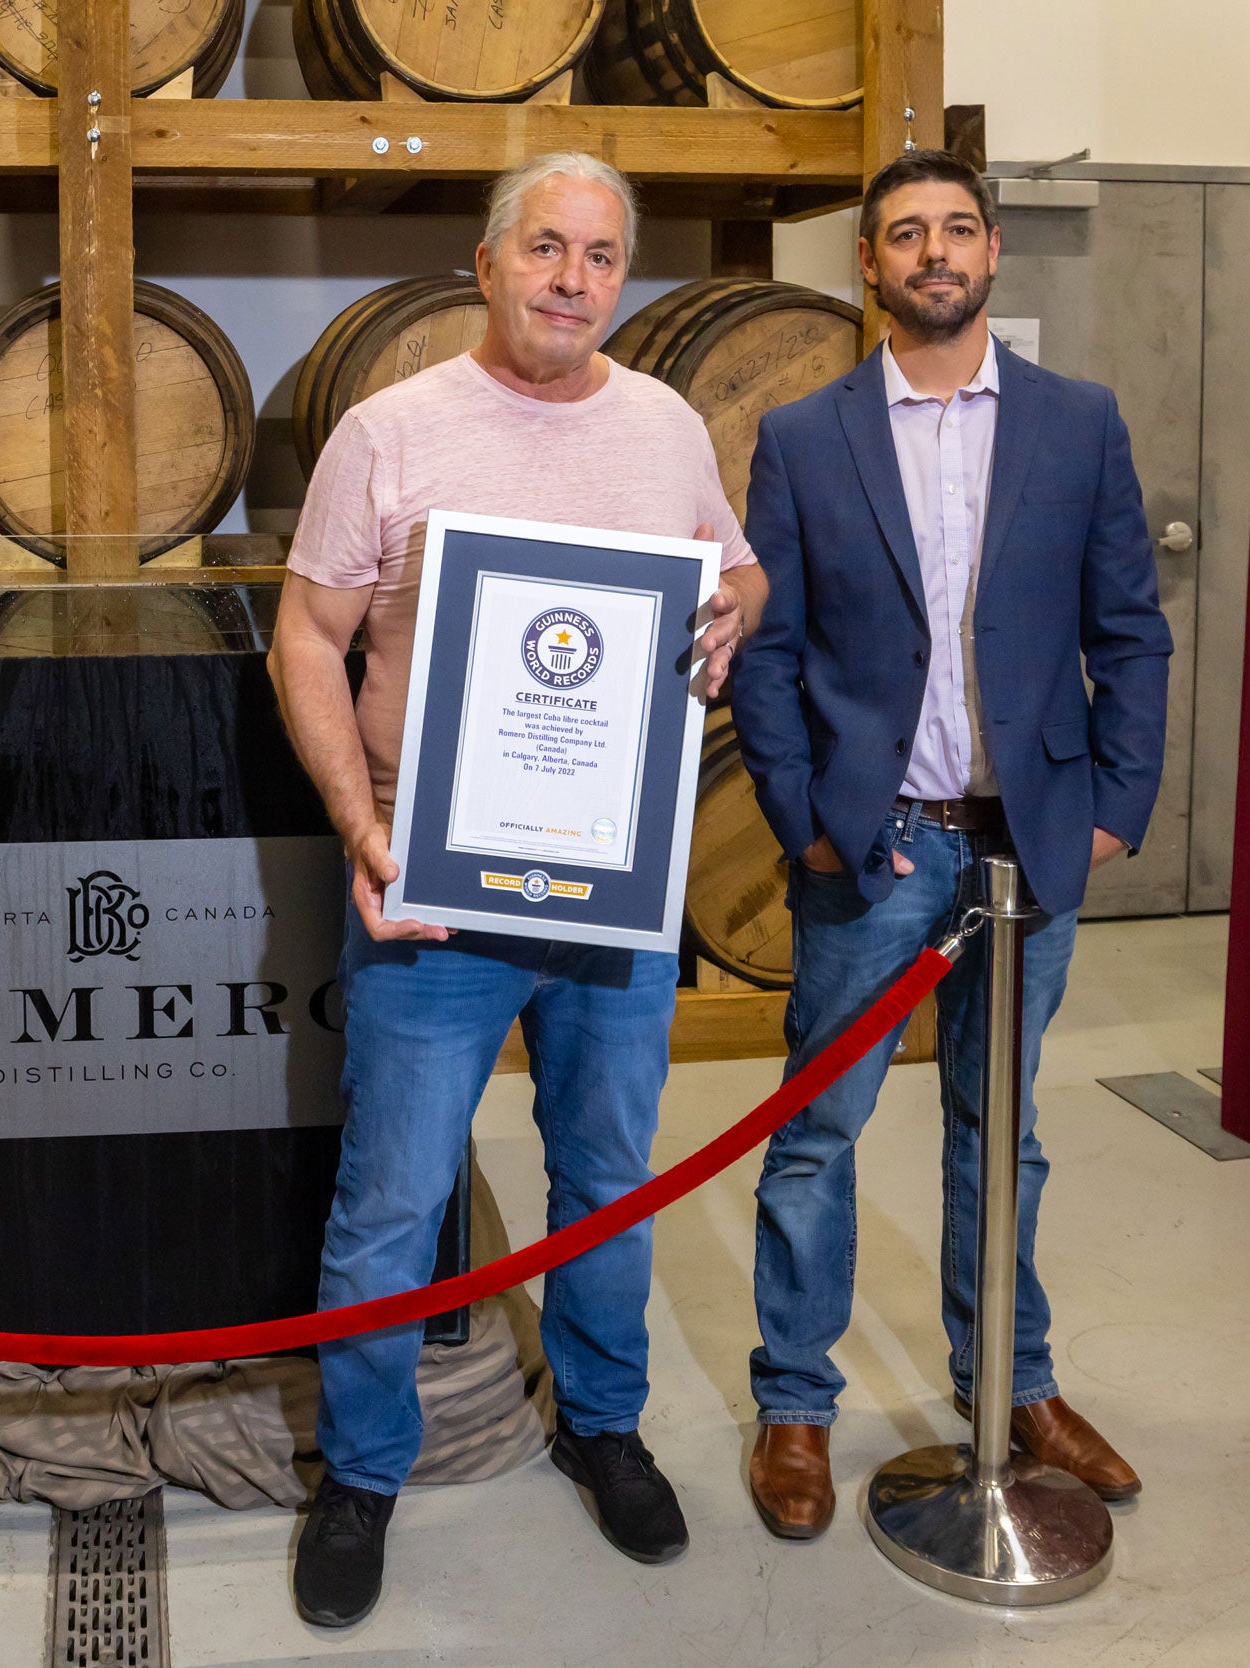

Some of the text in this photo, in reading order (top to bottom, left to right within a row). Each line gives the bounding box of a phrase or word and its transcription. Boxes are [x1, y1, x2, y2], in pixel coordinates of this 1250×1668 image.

[535, 612, 595, 637] GUINNESS
[526, 640, 599, 686] WORLD RECORDS
[515, 691, 598, 710] CERTIFICATE
[502, 708, 609, 728] The largest Cuba libre cocktail
[498, 728, 606, 748] Romero Distilling Company Ltd.
[524, 722, 584, 736] was achieved by
[536, 744, 567, 755] (Canada)
[502, 749, 510, 757] in
[571, 758, 598, 769] Canada
[523, 763, 533, 771] On
[540, 765, 556, 775] July
[557, 767, 576, 776] 2022
[500, 821, 582, 837] OFFICIALLY AMAZING
[488, 877, 521, 887] RECORD
[551, 884, 584, 895] HOLDER
[165, 905, 276, 921] CANADA
[189, 1061, 236, 1078] Co.
